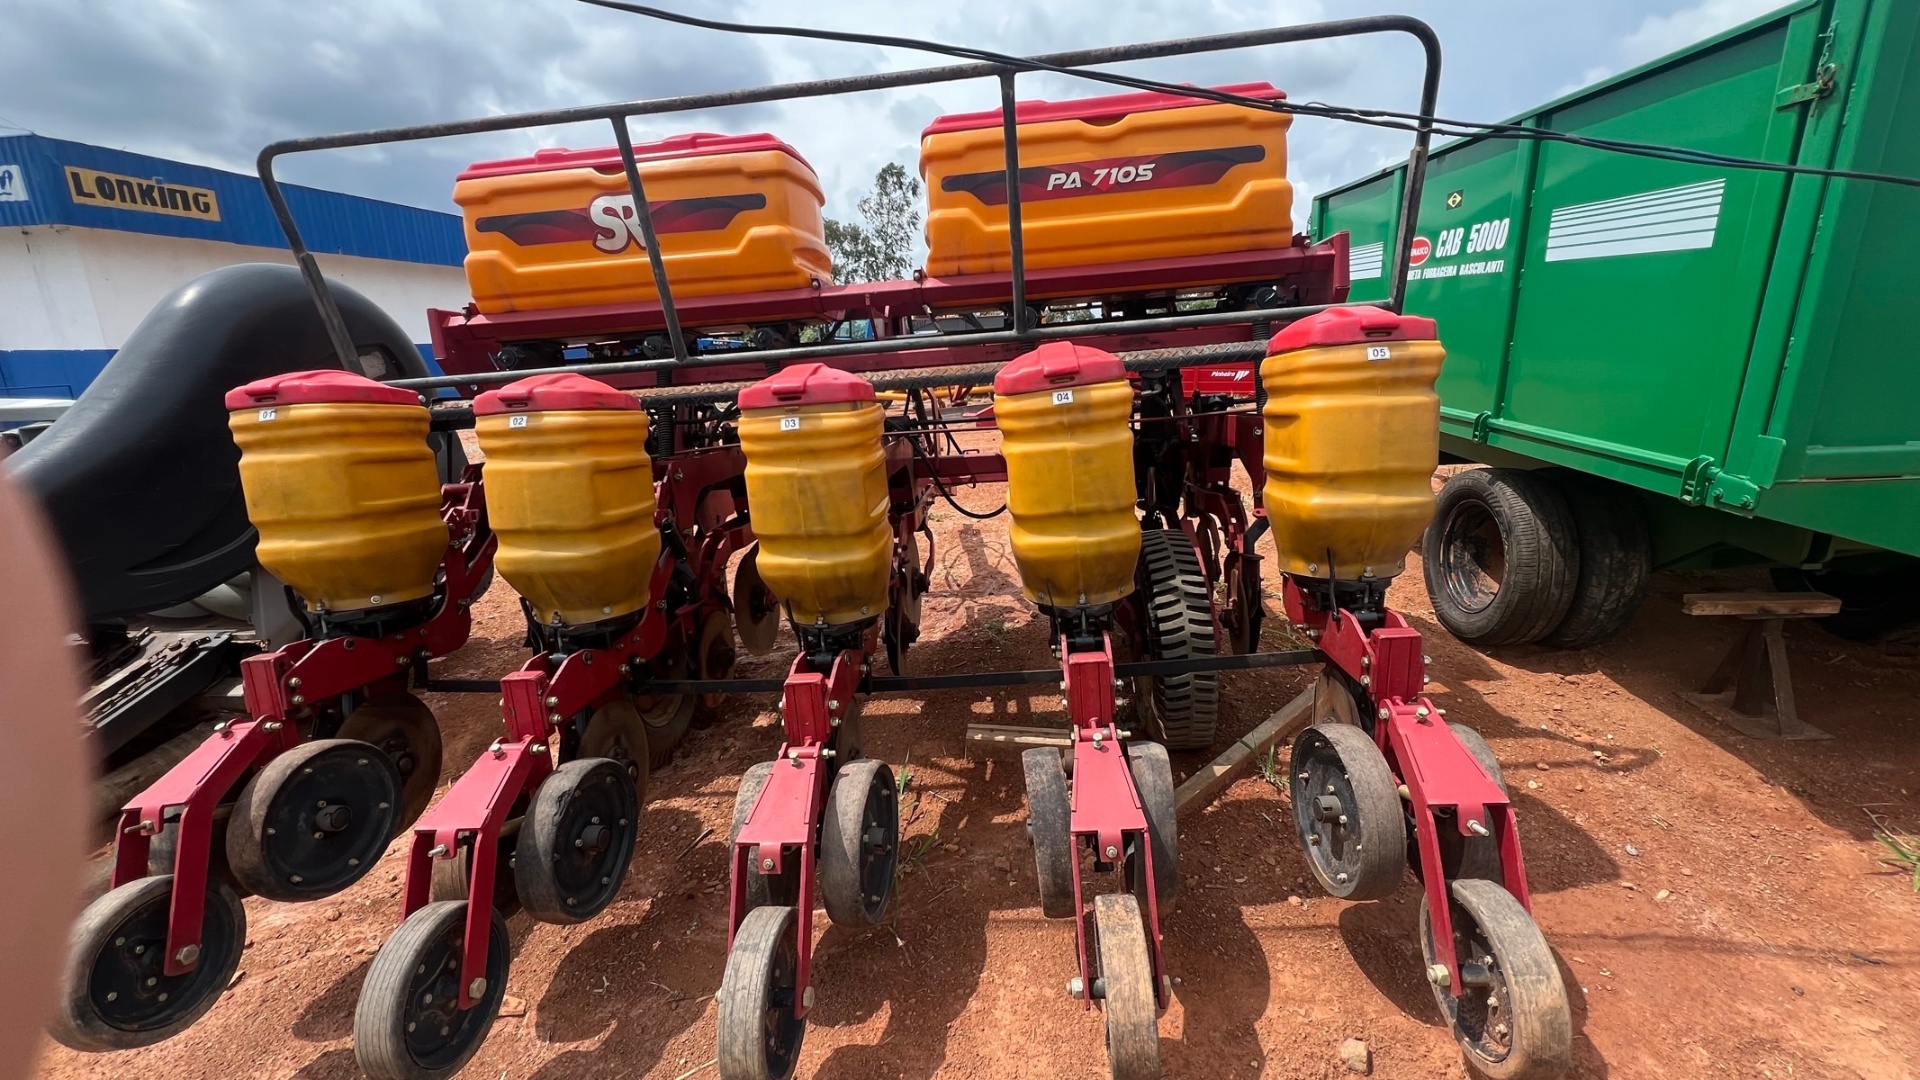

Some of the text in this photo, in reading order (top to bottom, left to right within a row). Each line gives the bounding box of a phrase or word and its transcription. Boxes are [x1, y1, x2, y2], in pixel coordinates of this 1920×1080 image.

[1047, 163, 1156, 191] PA 7105
[1435, 217, 1511, 258] CAB 5000
[1372, 348, 1386, 358] 05
[1056, 391, 1070, 402] 04
[262, 410, 274, 419] 01
[512, 417, 524, 426] 02
[784, 418, 797, 429] 03
